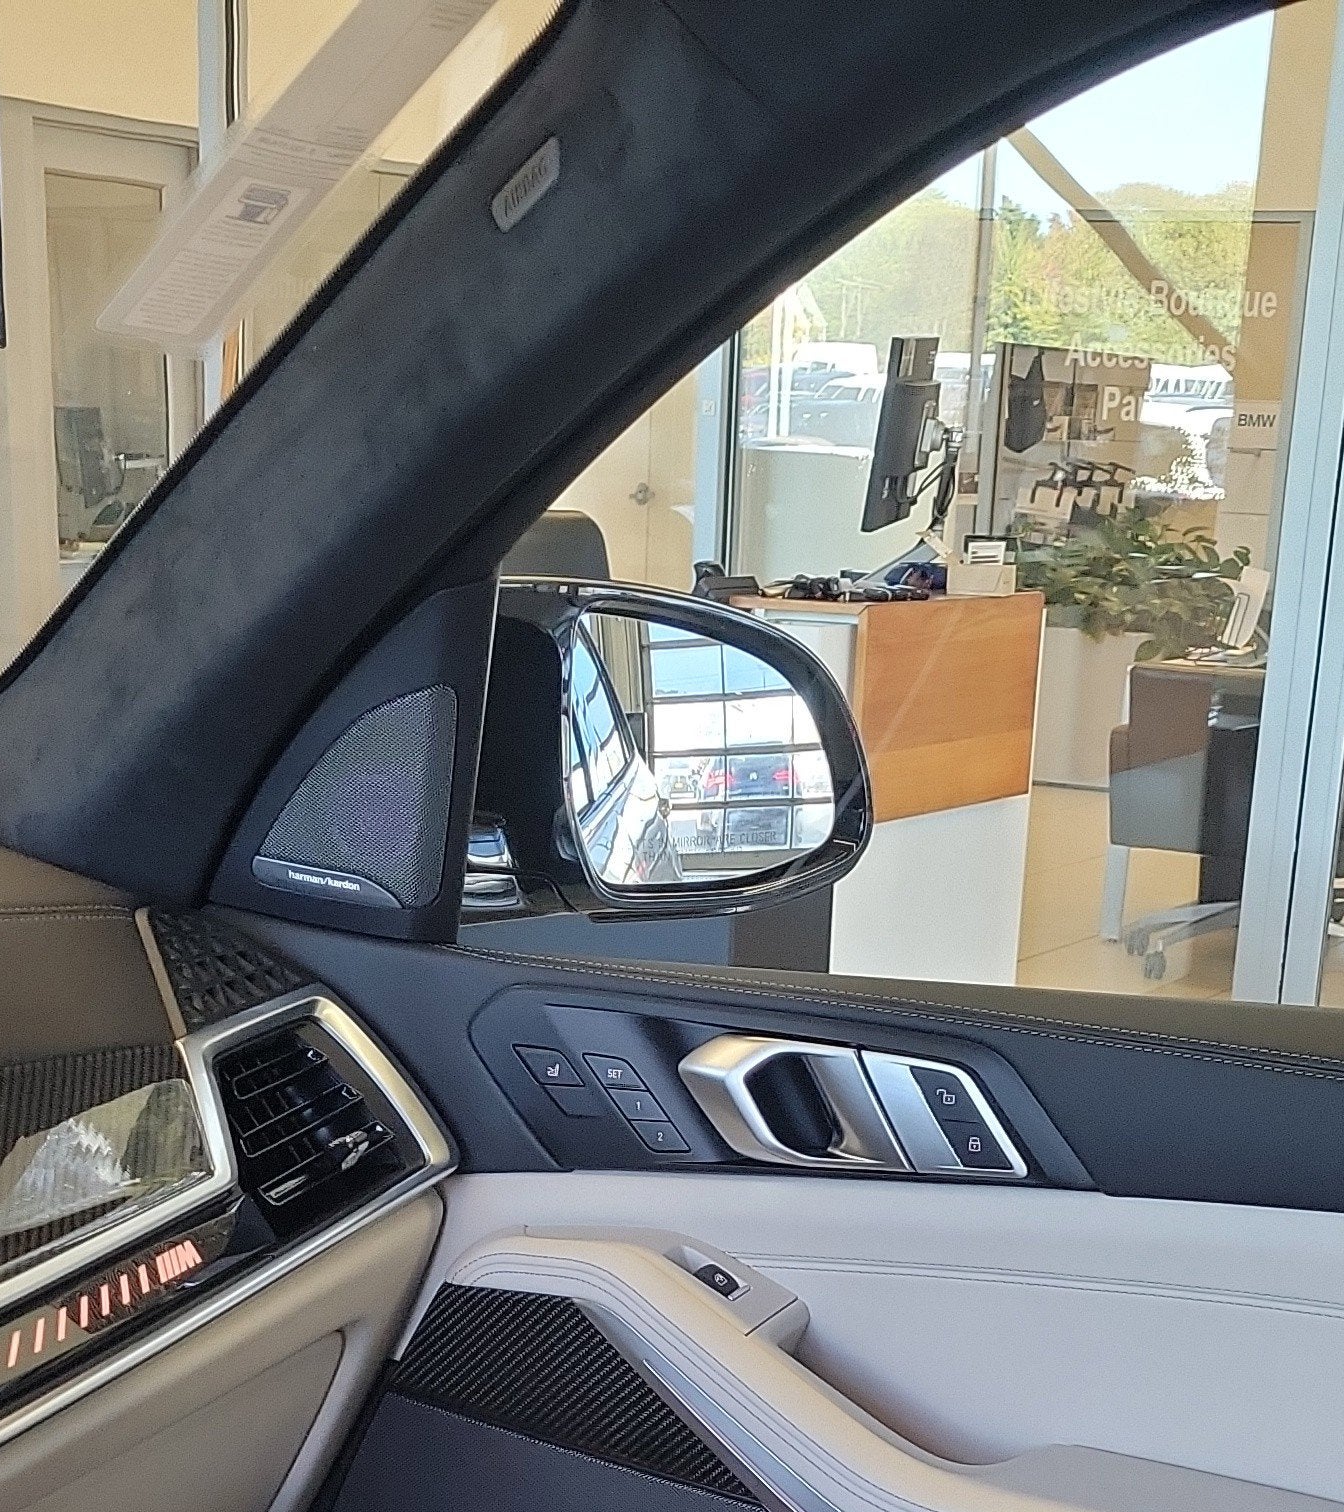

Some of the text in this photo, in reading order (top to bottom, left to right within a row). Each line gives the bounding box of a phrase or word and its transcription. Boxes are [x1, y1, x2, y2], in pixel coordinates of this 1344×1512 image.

[1238, 414, 1276, 428] BMW
[672, 835, 711, 848] MIRROR
[739, 830, 777, 843] CLOSER
[287, 868, 360, 891] harman/kardon
[607, 1068, 623, 1079] SET
